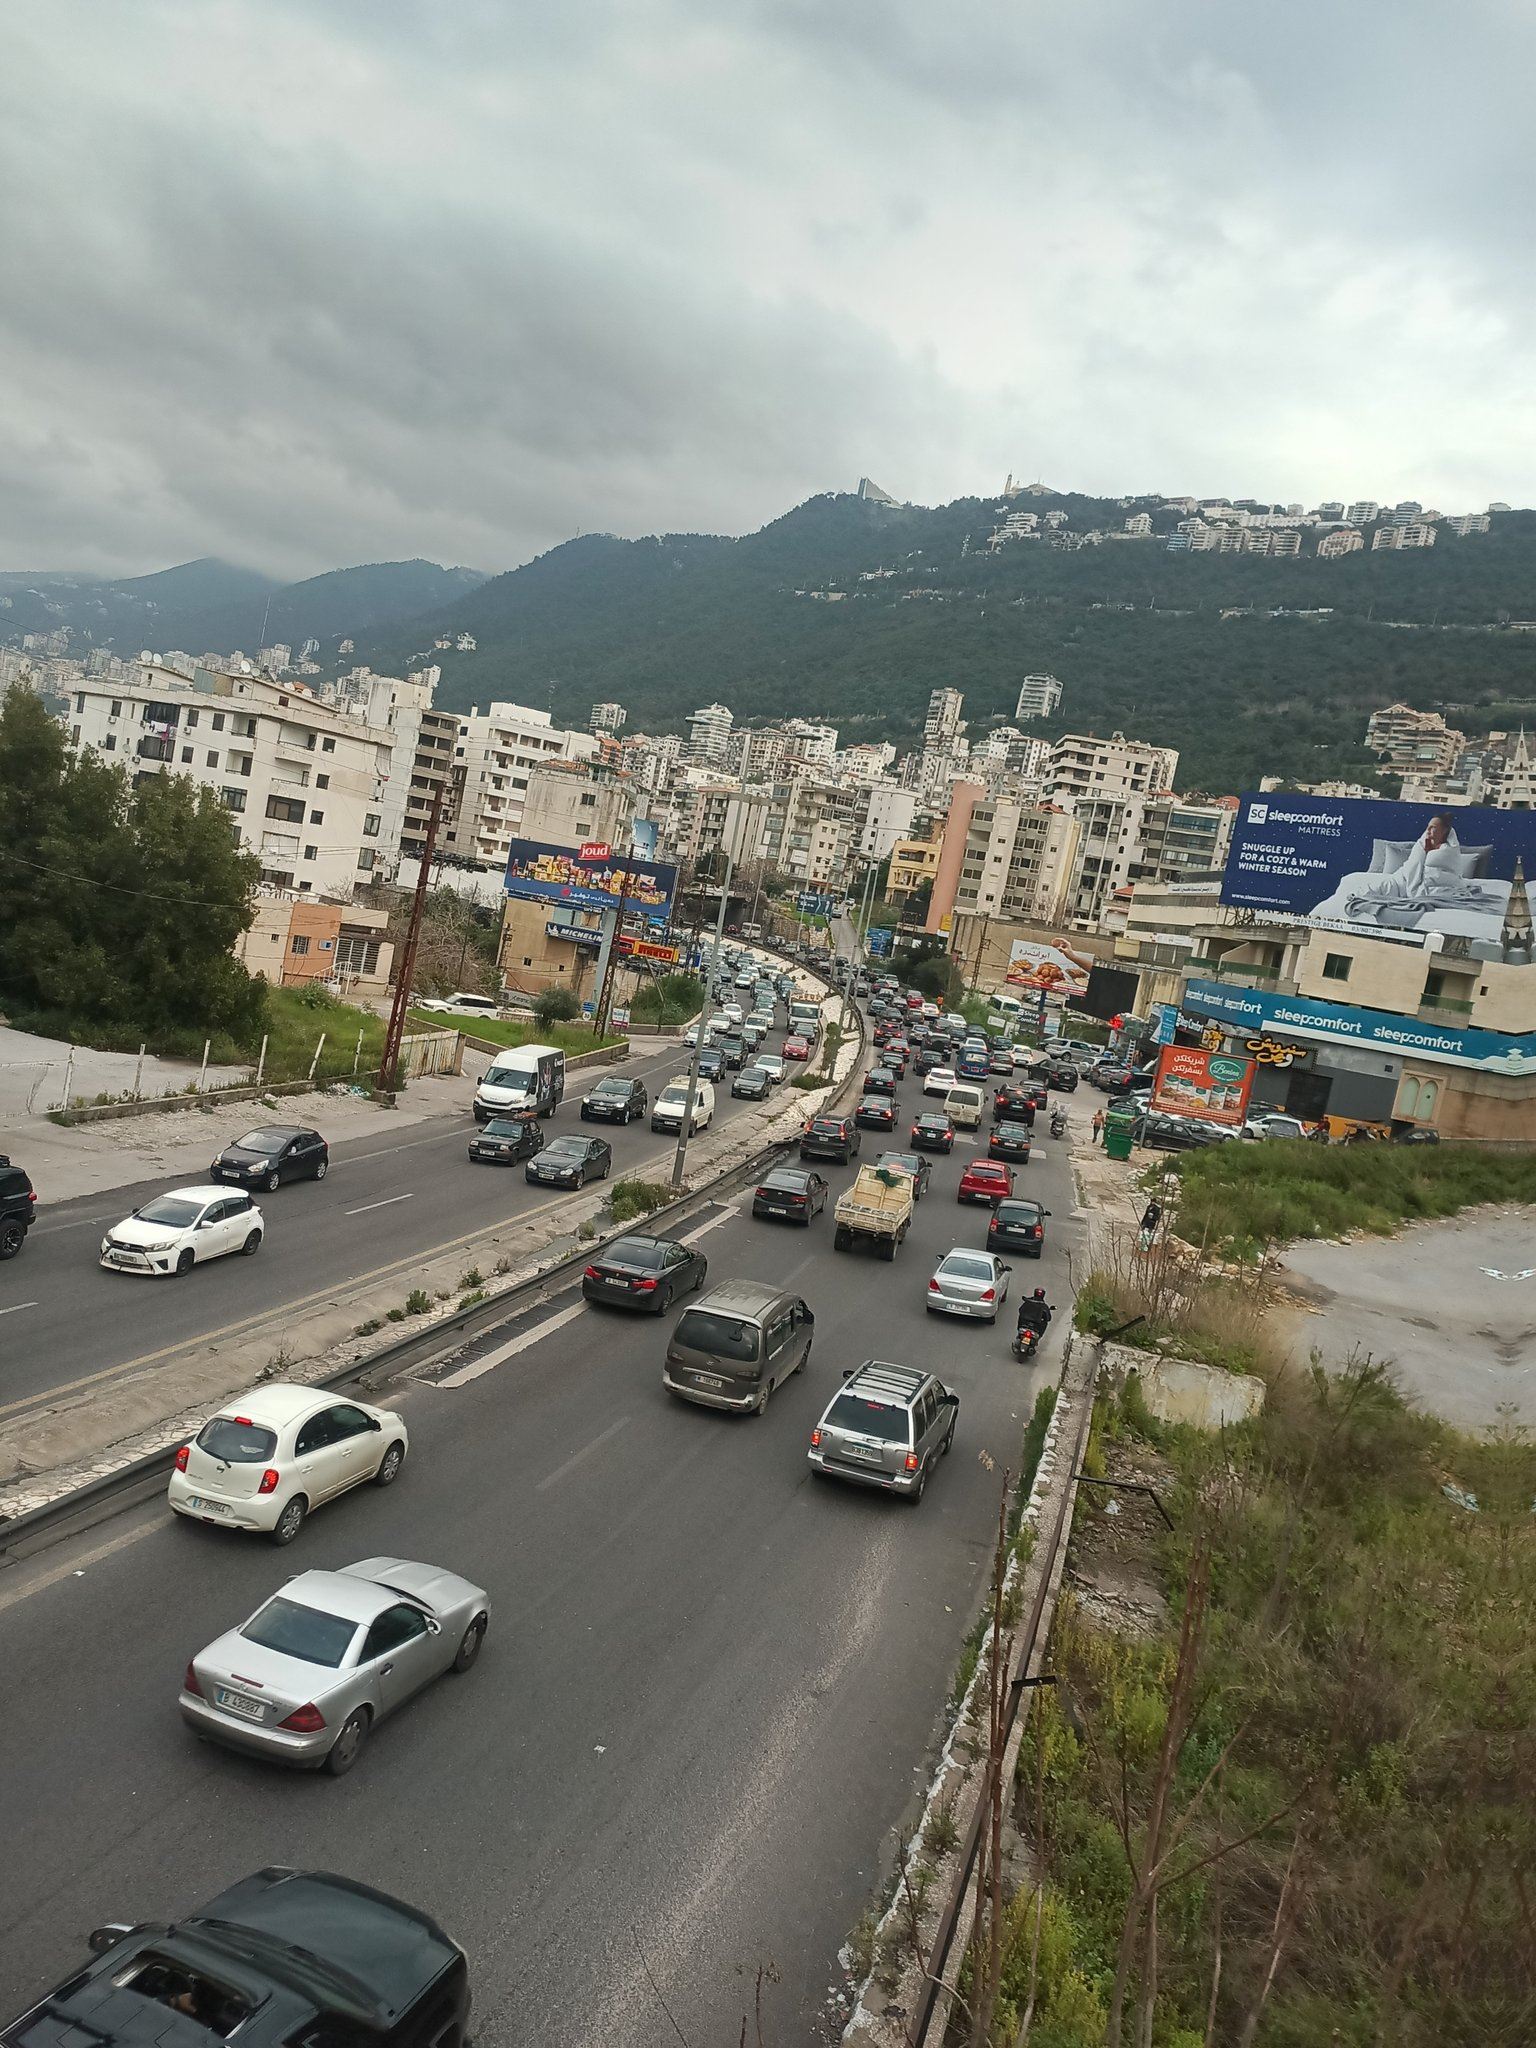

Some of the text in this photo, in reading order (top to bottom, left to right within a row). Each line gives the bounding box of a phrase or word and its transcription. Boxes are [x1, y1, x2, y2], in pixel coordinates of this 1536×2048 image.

[1250, 808, 1344, 826] SC sleepcomfort
[1298, 826, 1341, 837] MATTRESS
[581, 845, 608, 858] joud
[1242, 842, 1295, 856] SNUGGLE UP
[1240, 852, 1327, 869] FOR A COZY & WARM
[1238, 862, 1307, 877] WINTER SEASON
[560, 928, 603, 942] MICHELIN
[1274, 1008, 1362, 1034] sleepcomfort
[1374, 1026, 1462, 1051] sleepcomfort
